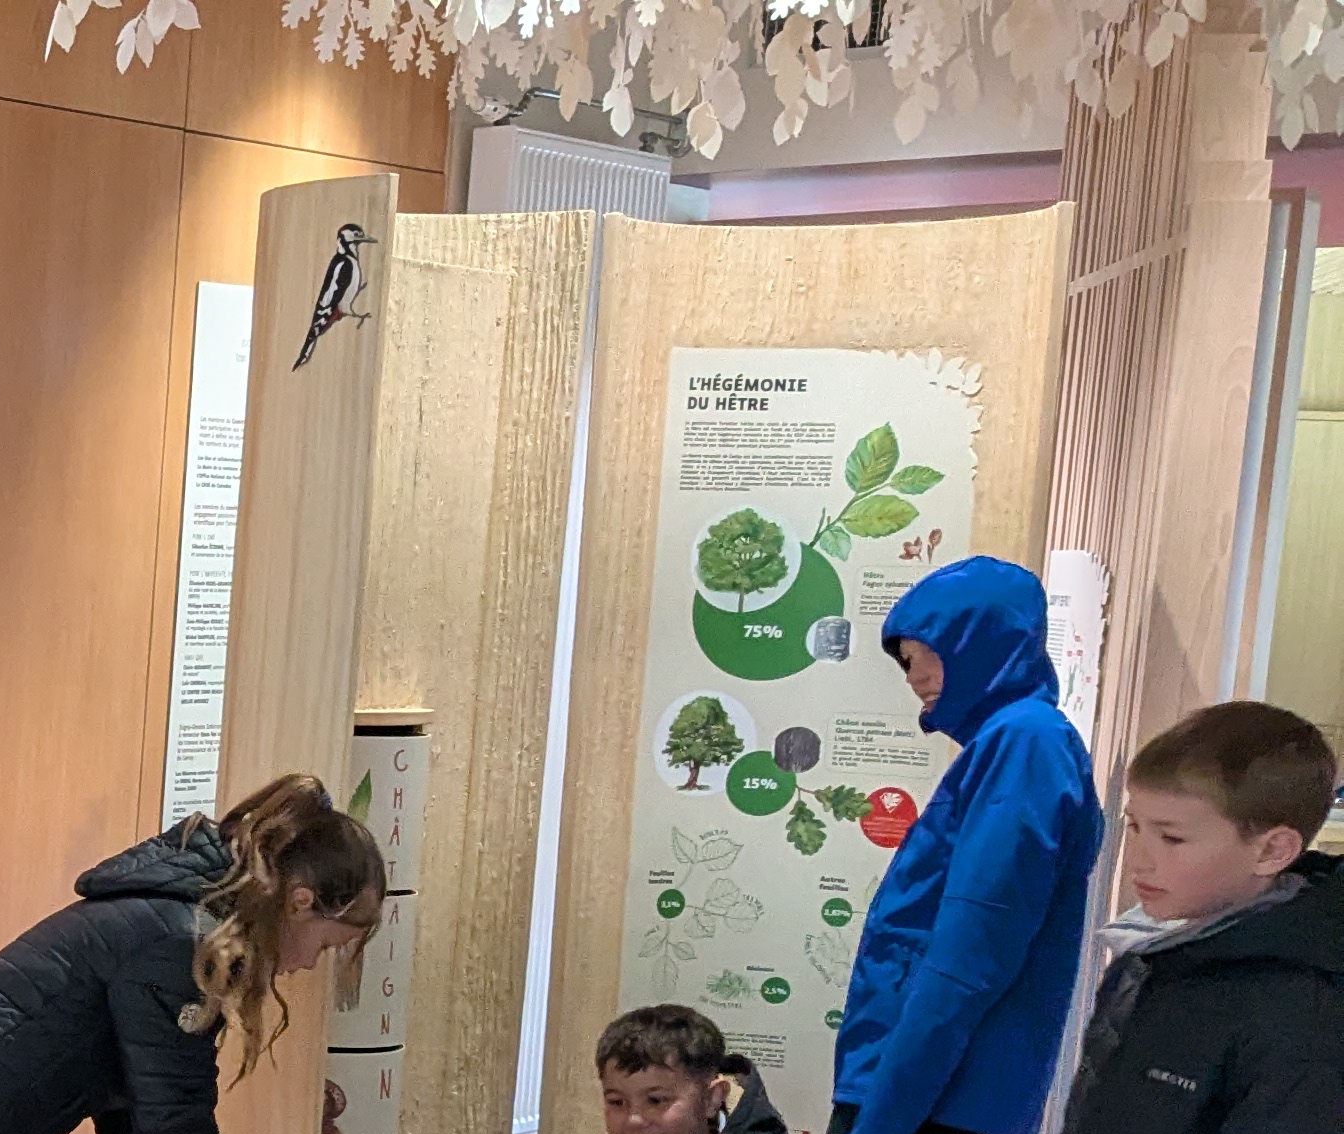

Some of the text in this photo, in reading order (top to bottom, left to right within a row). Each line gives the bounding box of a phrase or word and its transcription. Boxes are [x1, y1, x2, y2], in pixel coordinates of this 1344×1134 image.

[689, 373, 807, 392] L'HÉGÉMONIE
[687, 392, 769, 411] DU HÊTRE
[743, 625, 783, 638] 75%
[742, 778, 777, 790] 15%
